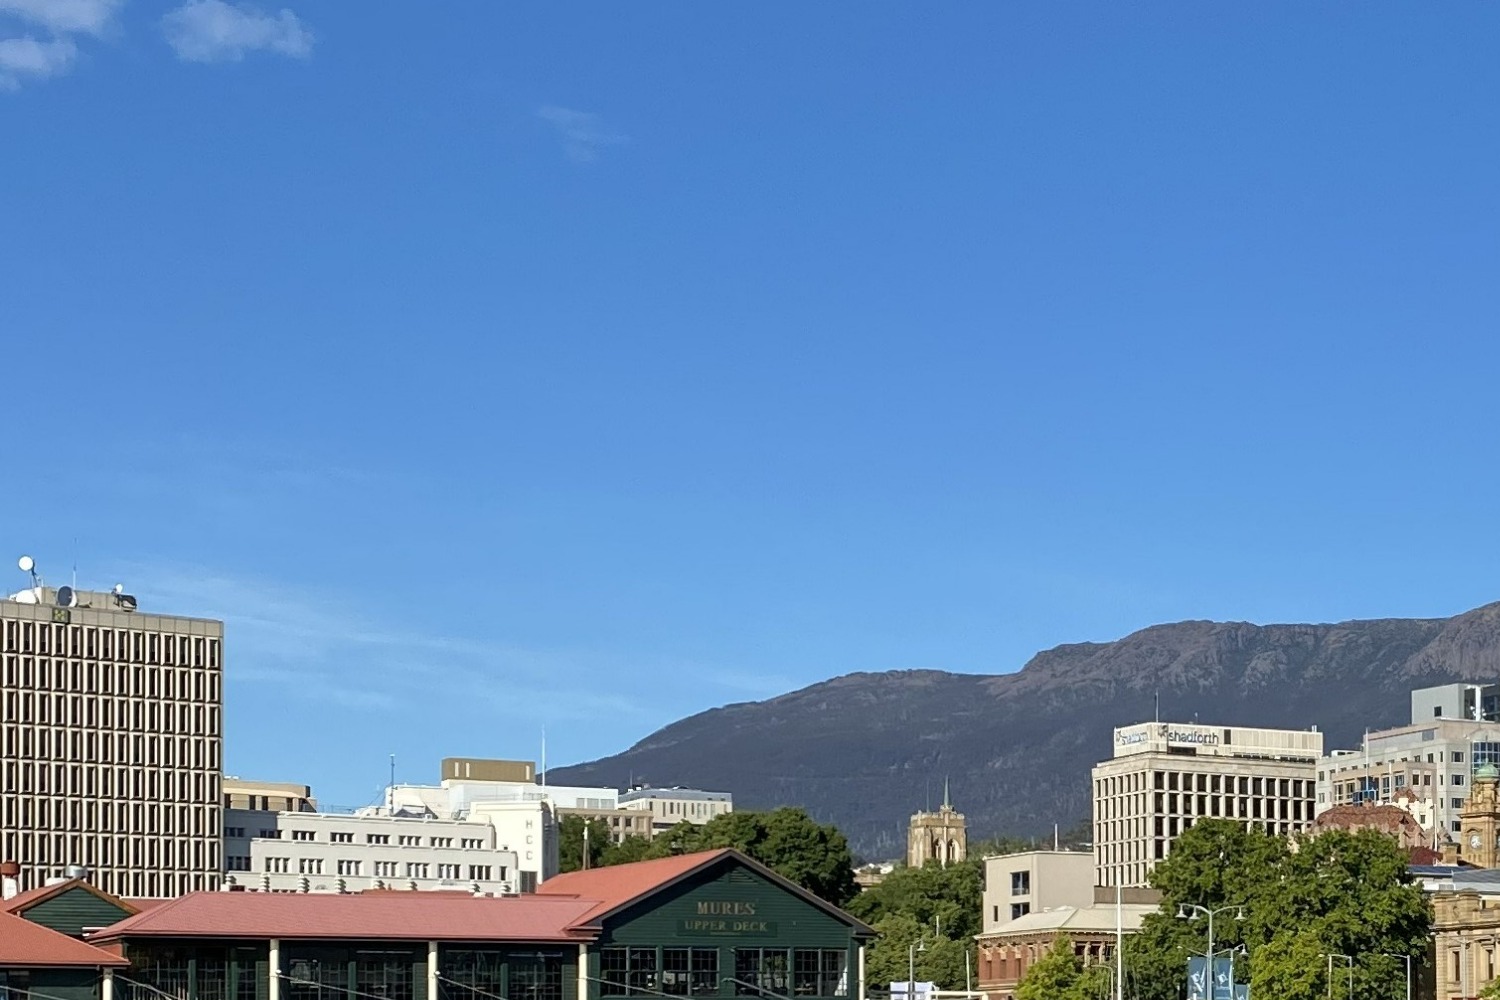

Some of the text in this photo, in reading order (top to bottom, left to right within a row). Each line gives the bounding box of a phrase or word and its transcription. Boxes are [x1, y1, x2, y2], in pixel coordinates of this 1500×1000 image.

[1168, 729, 1219, 744] shadforth
[697, 901, 756, 915] MURES
[684, 920, 768, 932] UPPER DECK
